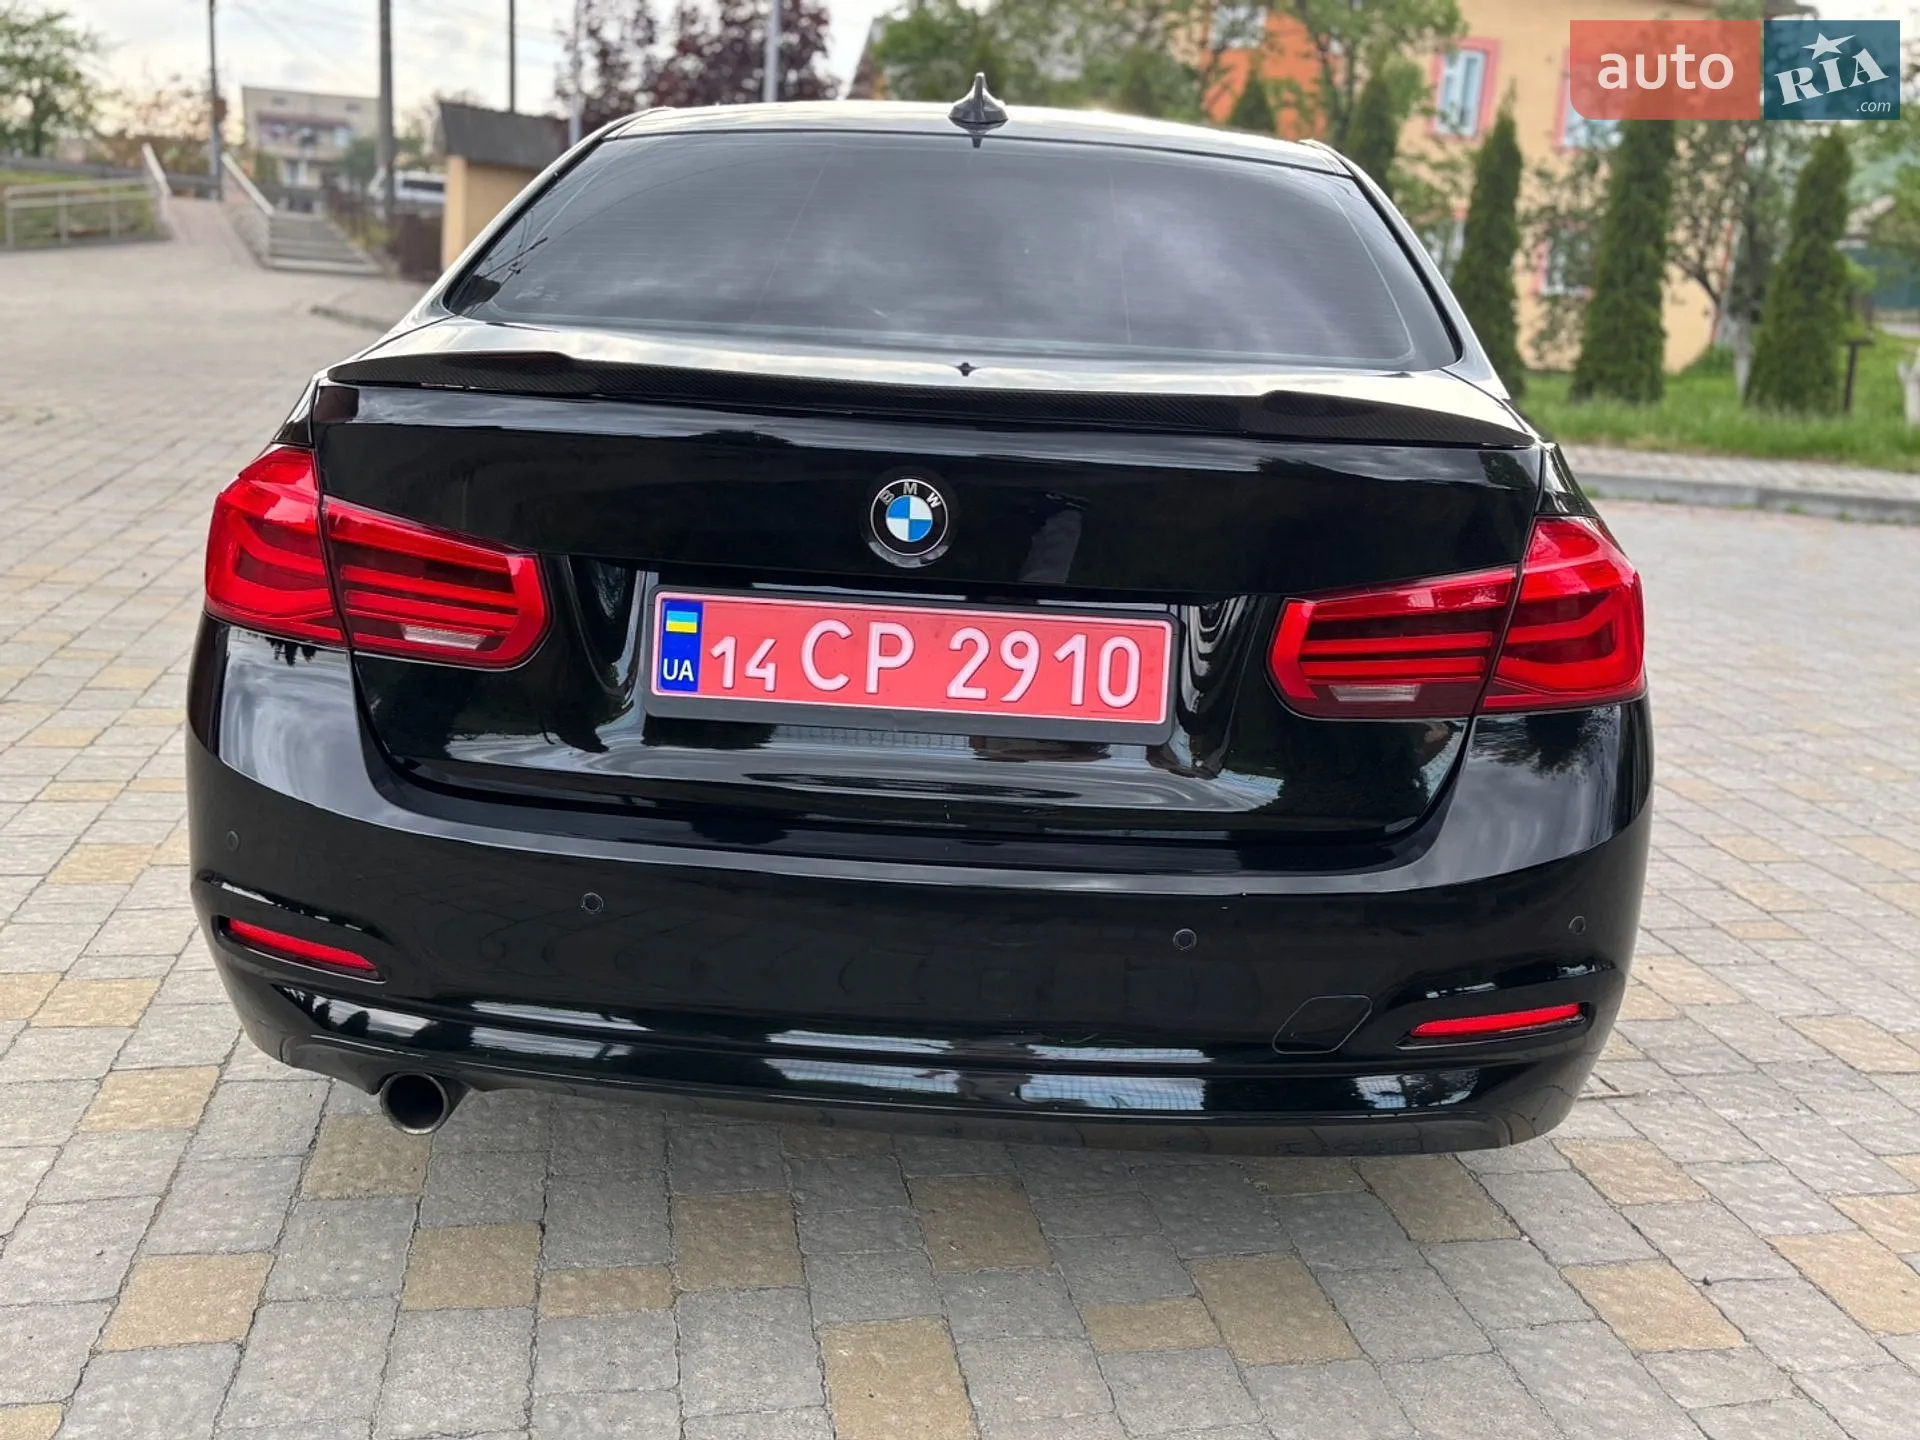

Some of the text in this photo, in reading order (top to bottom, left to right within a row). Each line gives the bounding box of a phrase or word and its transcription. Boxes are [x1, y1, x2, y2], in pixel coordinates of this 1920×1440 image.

[879, 481, 942, 508] BMW
[663, 657, 695, 682] UA
[709, 619, 1142, 709] 14 CP 2910
